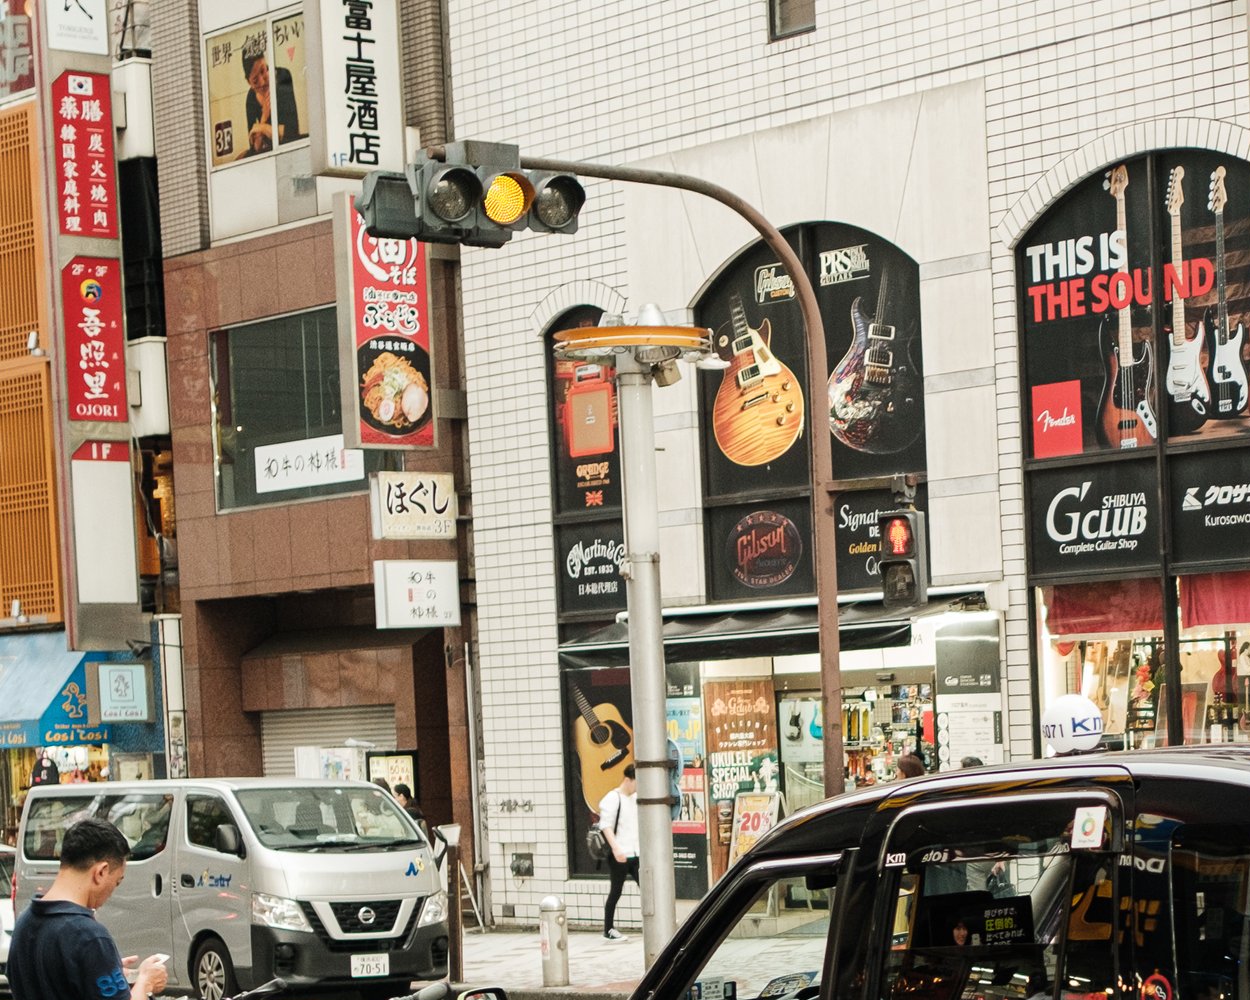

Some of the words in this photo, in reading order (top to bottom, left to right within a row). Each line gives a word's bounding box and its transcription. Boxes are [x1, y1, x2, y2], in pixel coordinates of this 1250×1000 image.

[342, 0, 381, 166] 富士屋酒店
[59, 95, 104, 122] 薬膳
[216, 128, 233, 152] 3F
[59, 124, 83, 232] 韓国家庭料理
[820, 247, 851, 277] PRS
[1026, 235, 1094, 283] THIS
[1099, 229, 1128, 271] IS
[1028, 283, 1086, 323] THE
[1090, 257, 1214, 313] SOUND
[76, 403, 118, 417] OJORI
[1036, 406, 1077, 433] Fender
[386, 480, 450, 515] ほぐし
[1102, 492, 1146, 509] SHIBUYA
[433, 519, 453, 535] 3F
[848, 542, 877, 555] Golden
[1059, 542, 1094, 555] Complete
[1095, 540, 1117, 551] Guitar
[1118, 538, 1138, 550] Shop
[45, 730, 75, 742] Cosi
[79, 728, 109, 741] Cosi
[711, 750, 754, 768] UKULELE
[712, 768, 753, 784] SPECIAL
[712, 781, 739, 799] SHOP
[96, 967, 129, 998] 85
